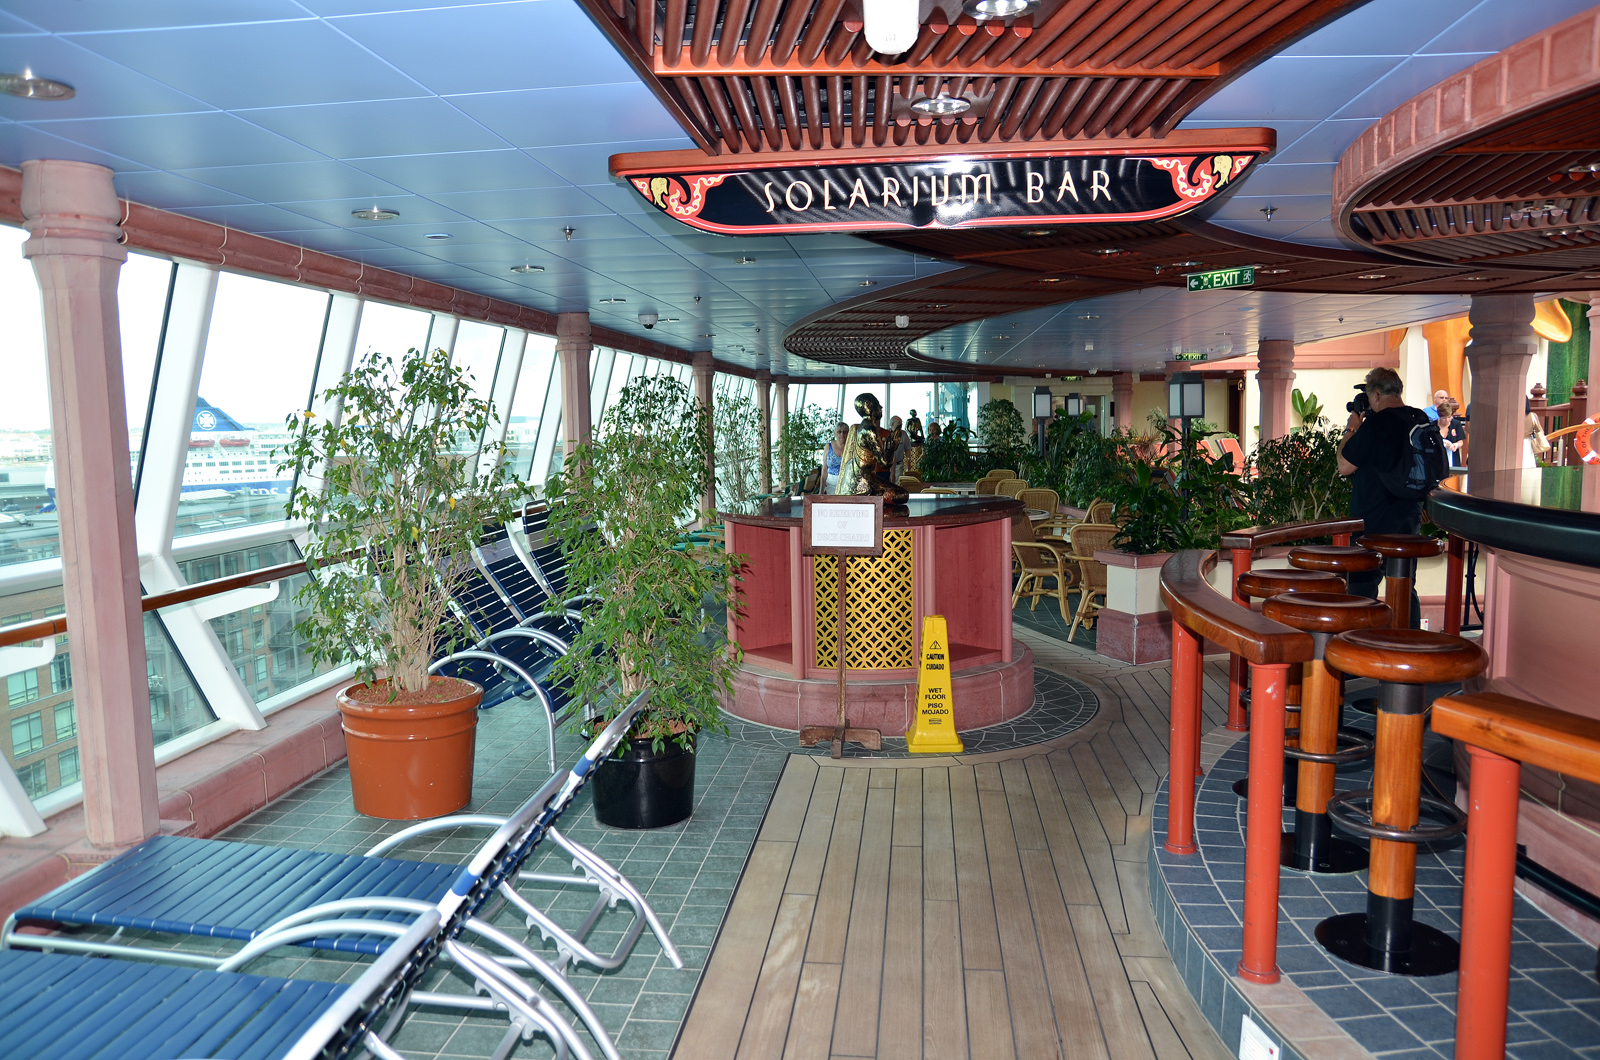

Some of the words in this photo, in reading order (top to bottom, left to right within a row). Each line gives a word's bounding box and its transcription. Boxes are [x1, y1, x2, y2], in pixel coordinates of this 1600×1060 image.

[764, 173, 992, 213] SOLARIUM
[1026, 170, 1112, 203] BAR
[1213, 271, 1240, 287] EXIT
[1188, 353, 1201, 361] EXIT
[817, 508, 828, 518] NO
[829, 509, 869, 518] RESERVING
[837, 520, 848, 529] OF
[816, 532, 838, 541] DECK
[839, 533, 870, 542] CHAIRS
